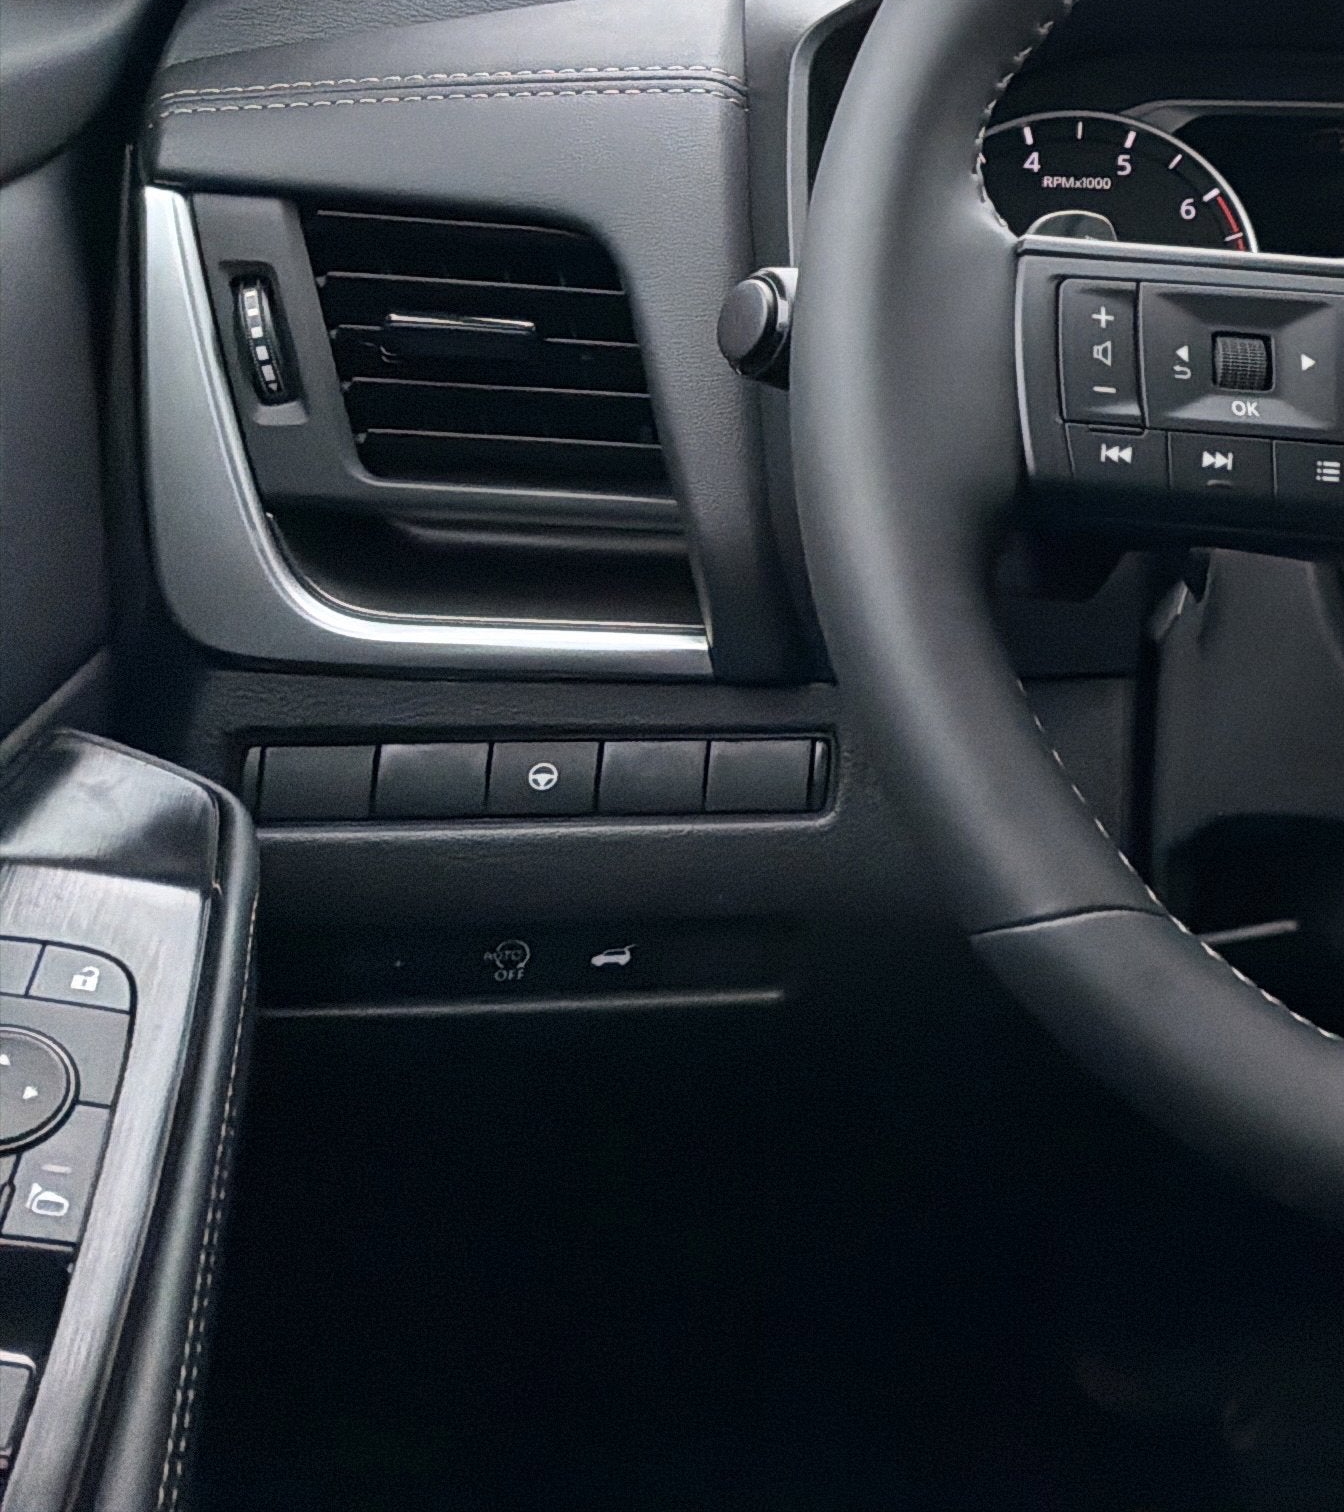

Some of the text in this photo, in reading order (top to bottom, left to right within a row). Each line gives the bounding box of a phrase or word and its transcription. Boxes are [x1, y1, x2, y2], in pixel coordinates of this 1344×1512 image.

[1023, 152, 1041, 172] 4
[1116, 154, 1132, 175] 5
[1042, 176, 1112, 190] RPMx1000
[1179, 198, 1196, 220] 6
[1231, 400, 1260, 417] OK
[494, 968, 525, 981] OFF
